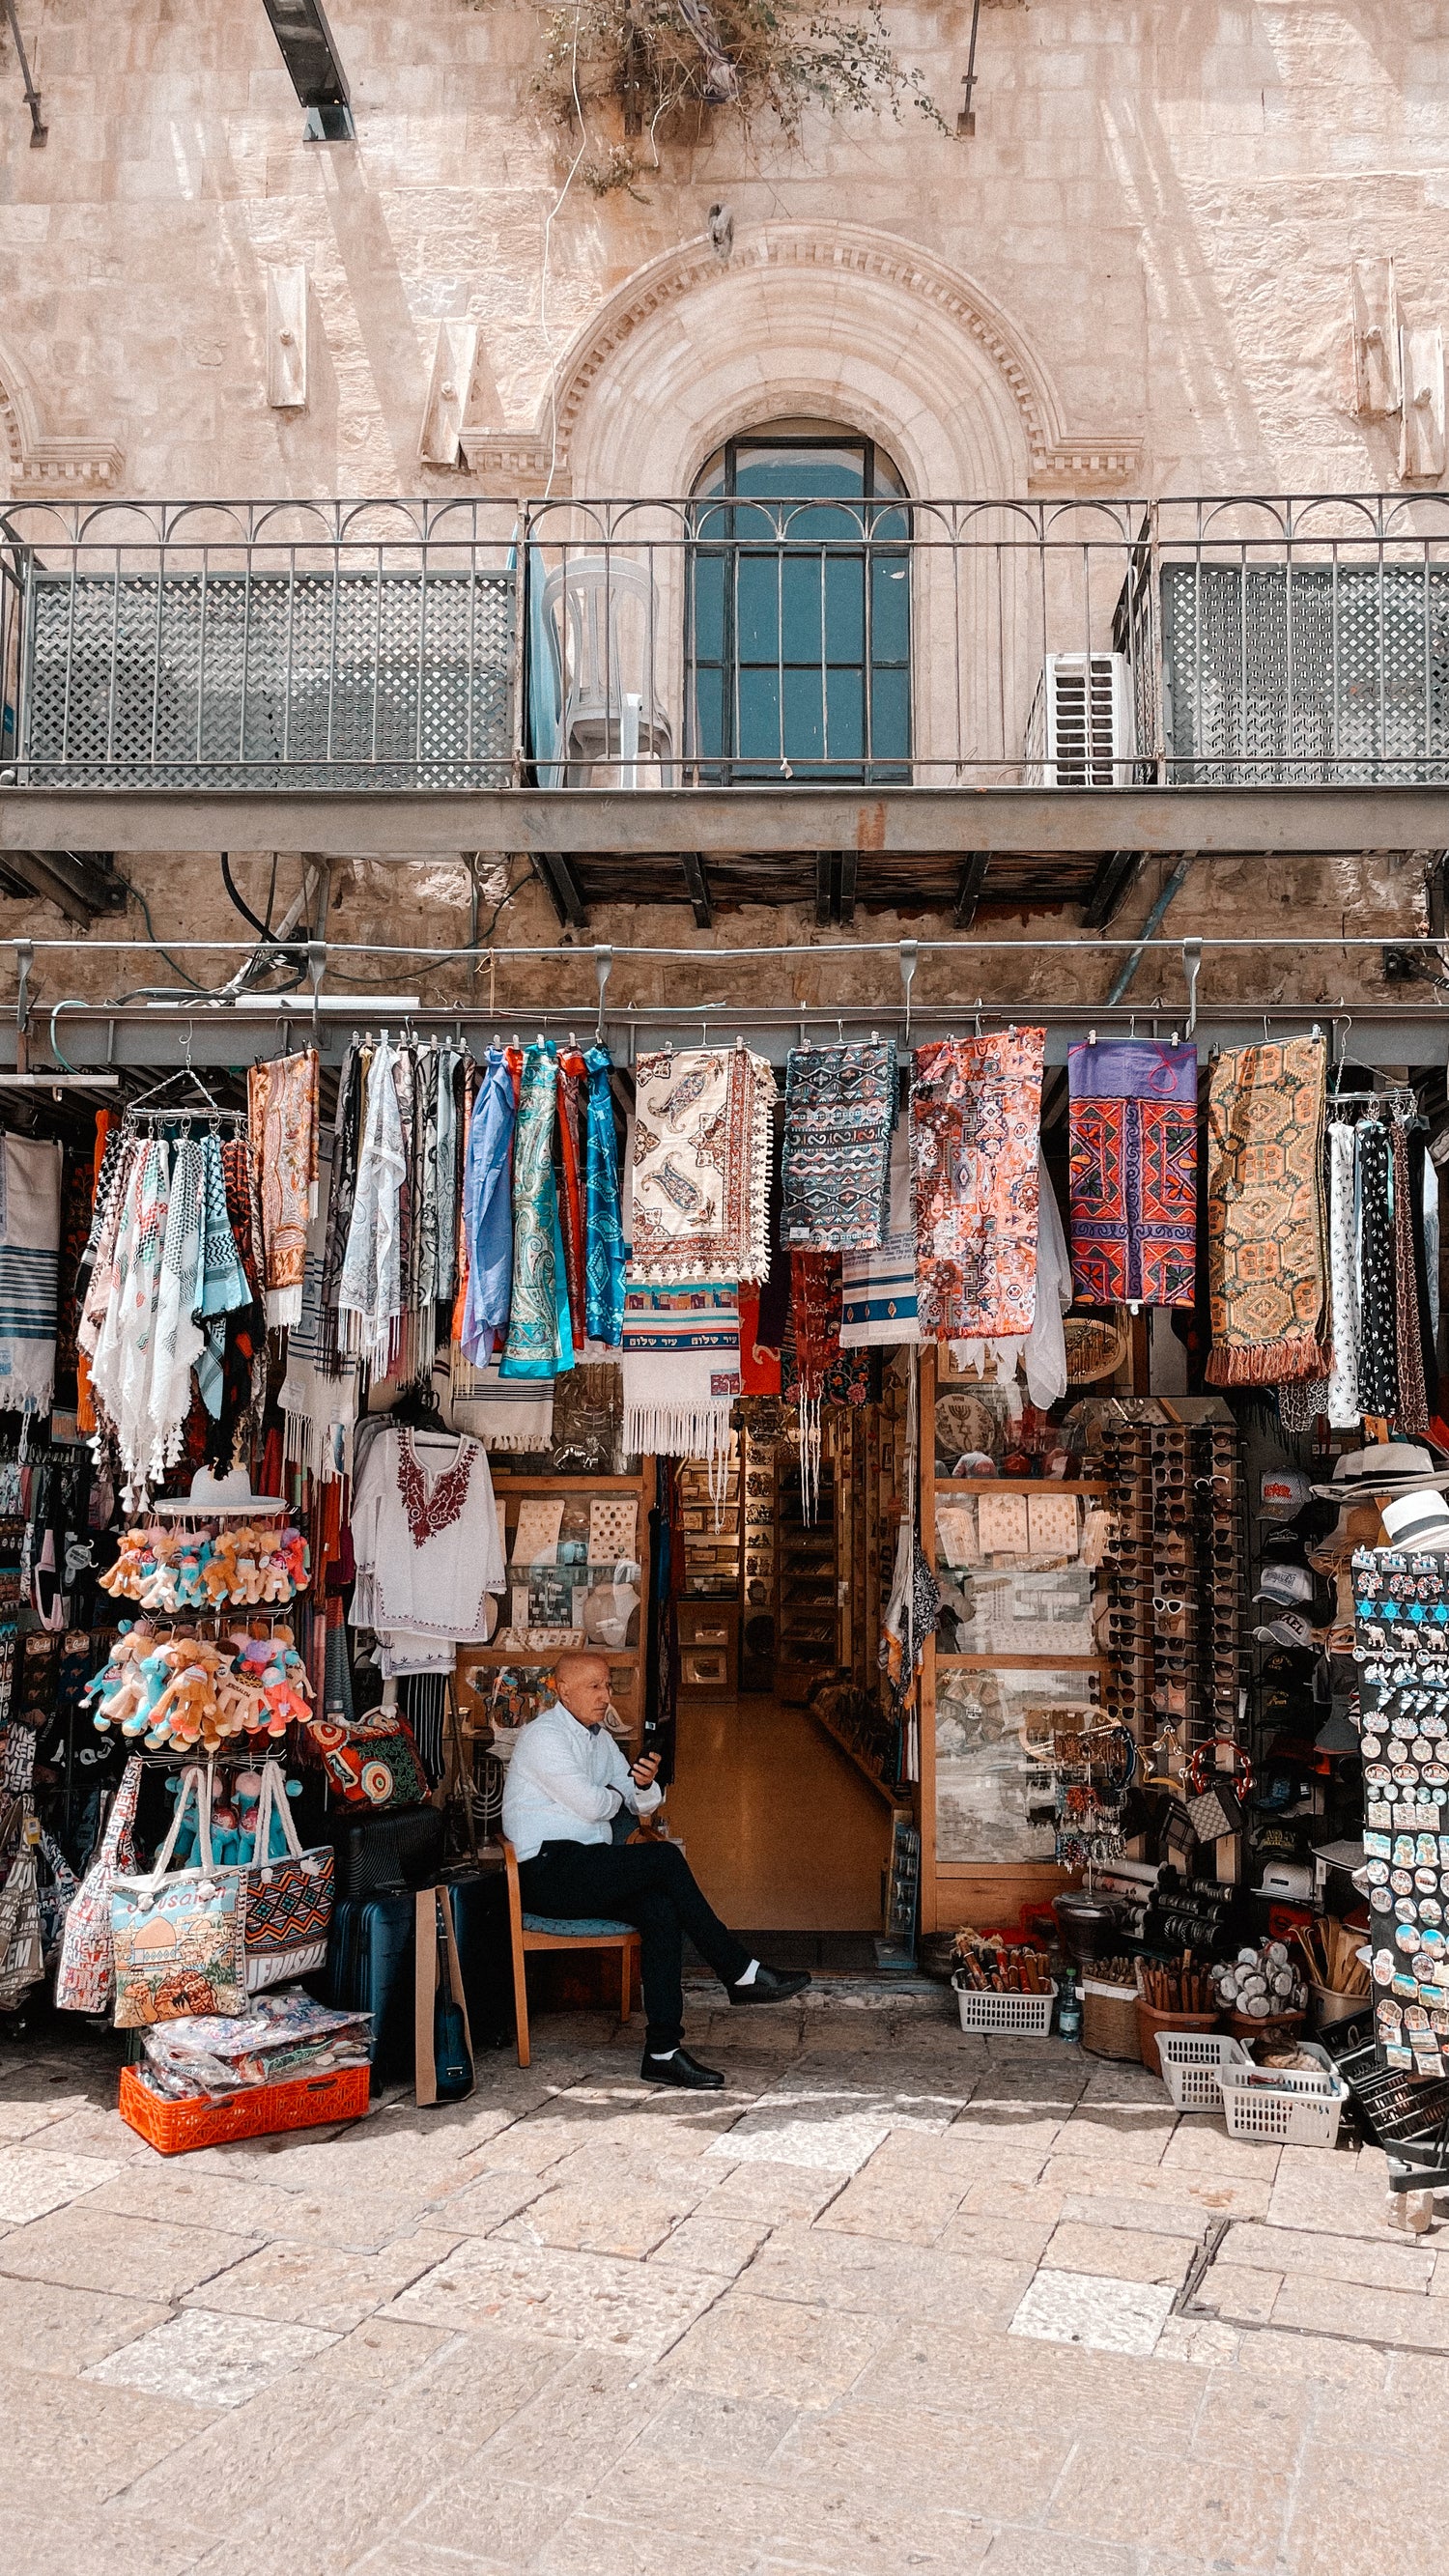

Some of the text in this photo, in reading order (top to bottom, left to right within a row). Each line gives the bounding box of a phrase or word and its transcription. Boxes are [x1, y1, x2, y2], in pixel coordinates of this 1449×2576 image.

[629, 1336, 657, 1346] שלום
[661, 1338, 678, 1346] עיר
[692, 1334, 719, 1345] שלום
